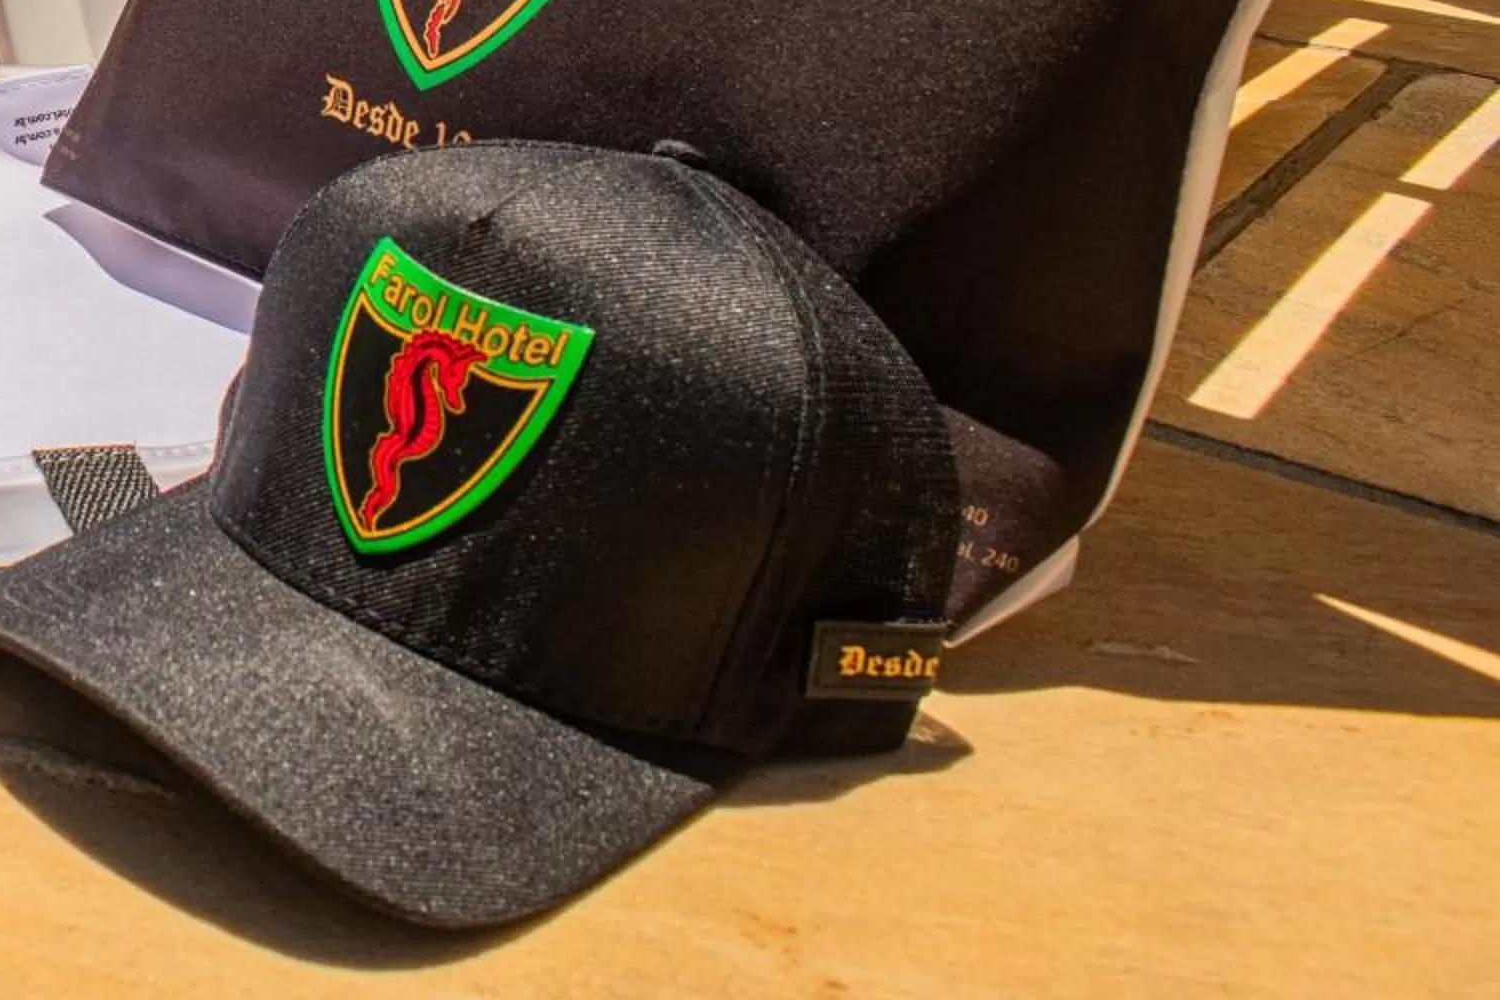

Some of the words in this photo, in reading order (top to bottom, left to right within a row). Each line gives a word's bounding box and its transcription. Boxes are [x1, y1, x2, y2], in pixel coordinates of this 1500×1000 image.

[321, 72, 420, 151] Desde
[370, 253, 448, 329] Farol
[453, 303, 572, 366] Hotel
[840, 645, 939, 678] Desde
